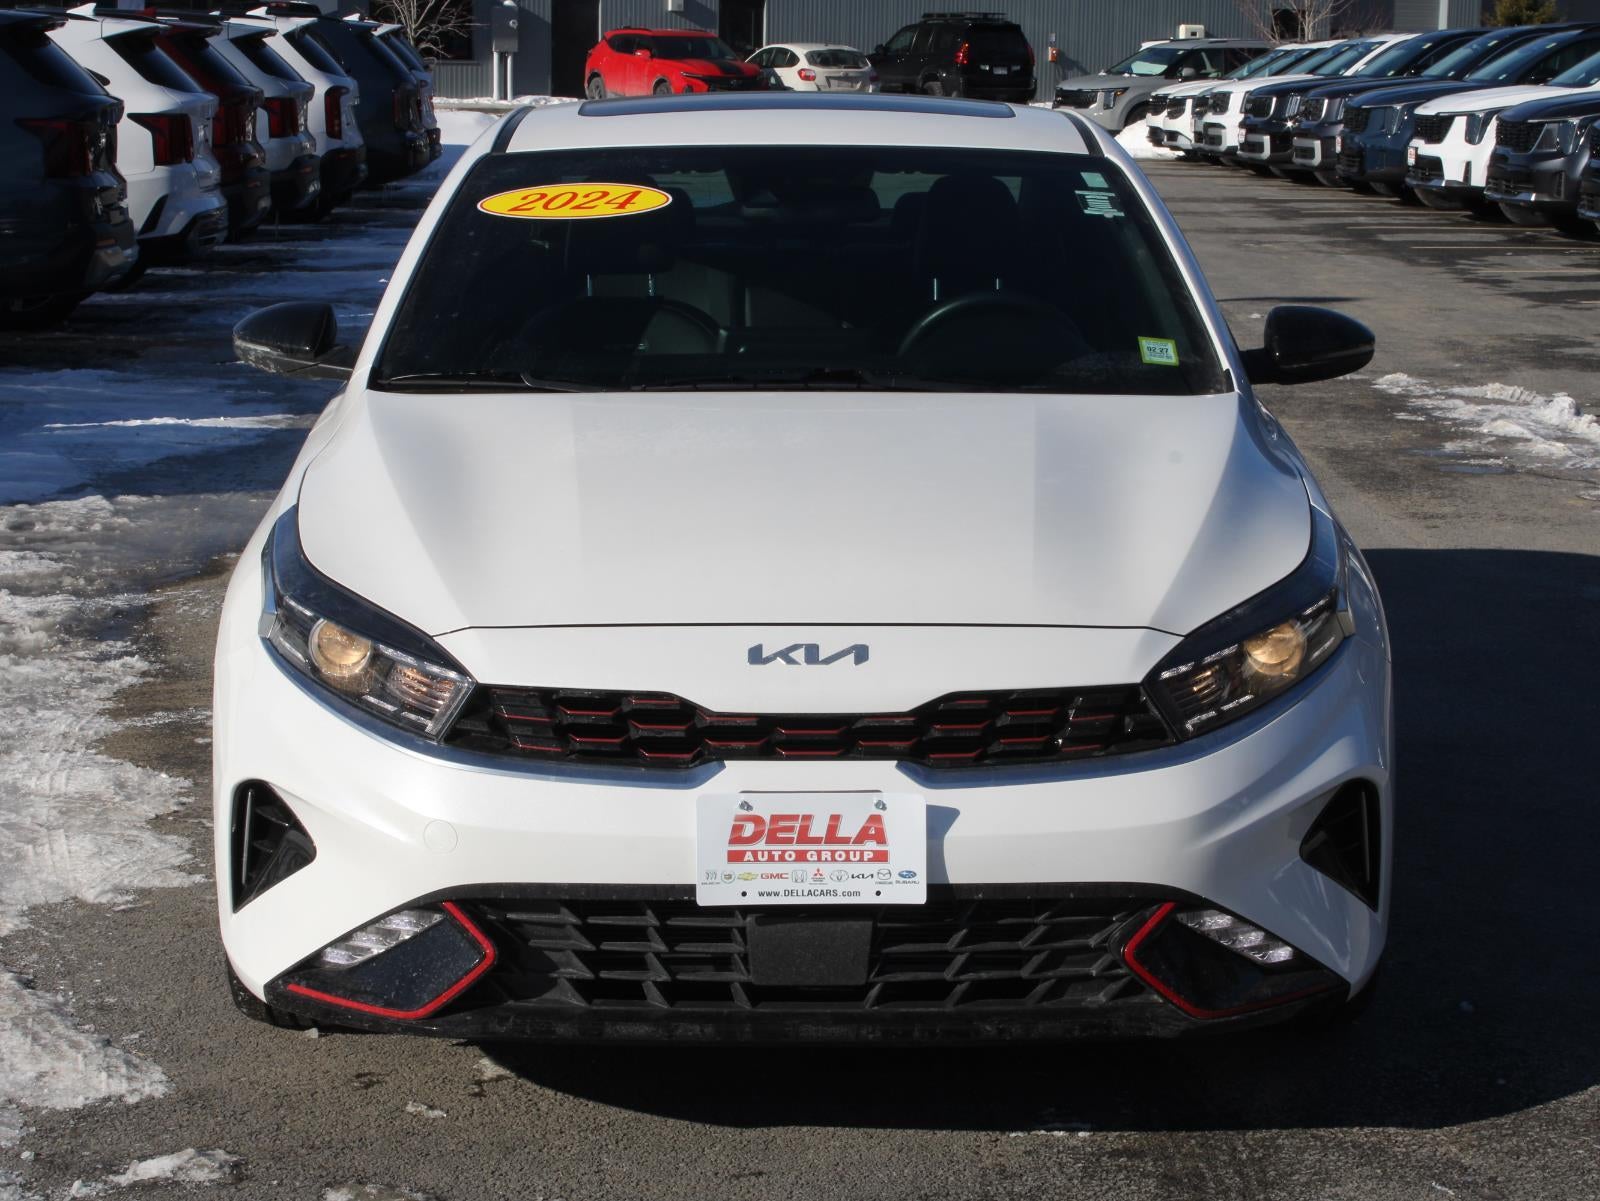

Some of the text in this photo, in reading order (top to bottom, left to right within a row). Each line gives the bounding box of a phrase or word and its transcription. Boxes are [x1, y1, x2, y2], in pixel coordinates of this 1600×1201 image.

[507, 190, 643, 212] 2024
[747, 643, 869, 666] KIA
[728, 813, 889, 846] DELLA
[743, 850, 875, 862] AUTO GROUP
[760, 872, 790, 880] GMC
[758, 888, 861, 898] www.DELLACARS.com
